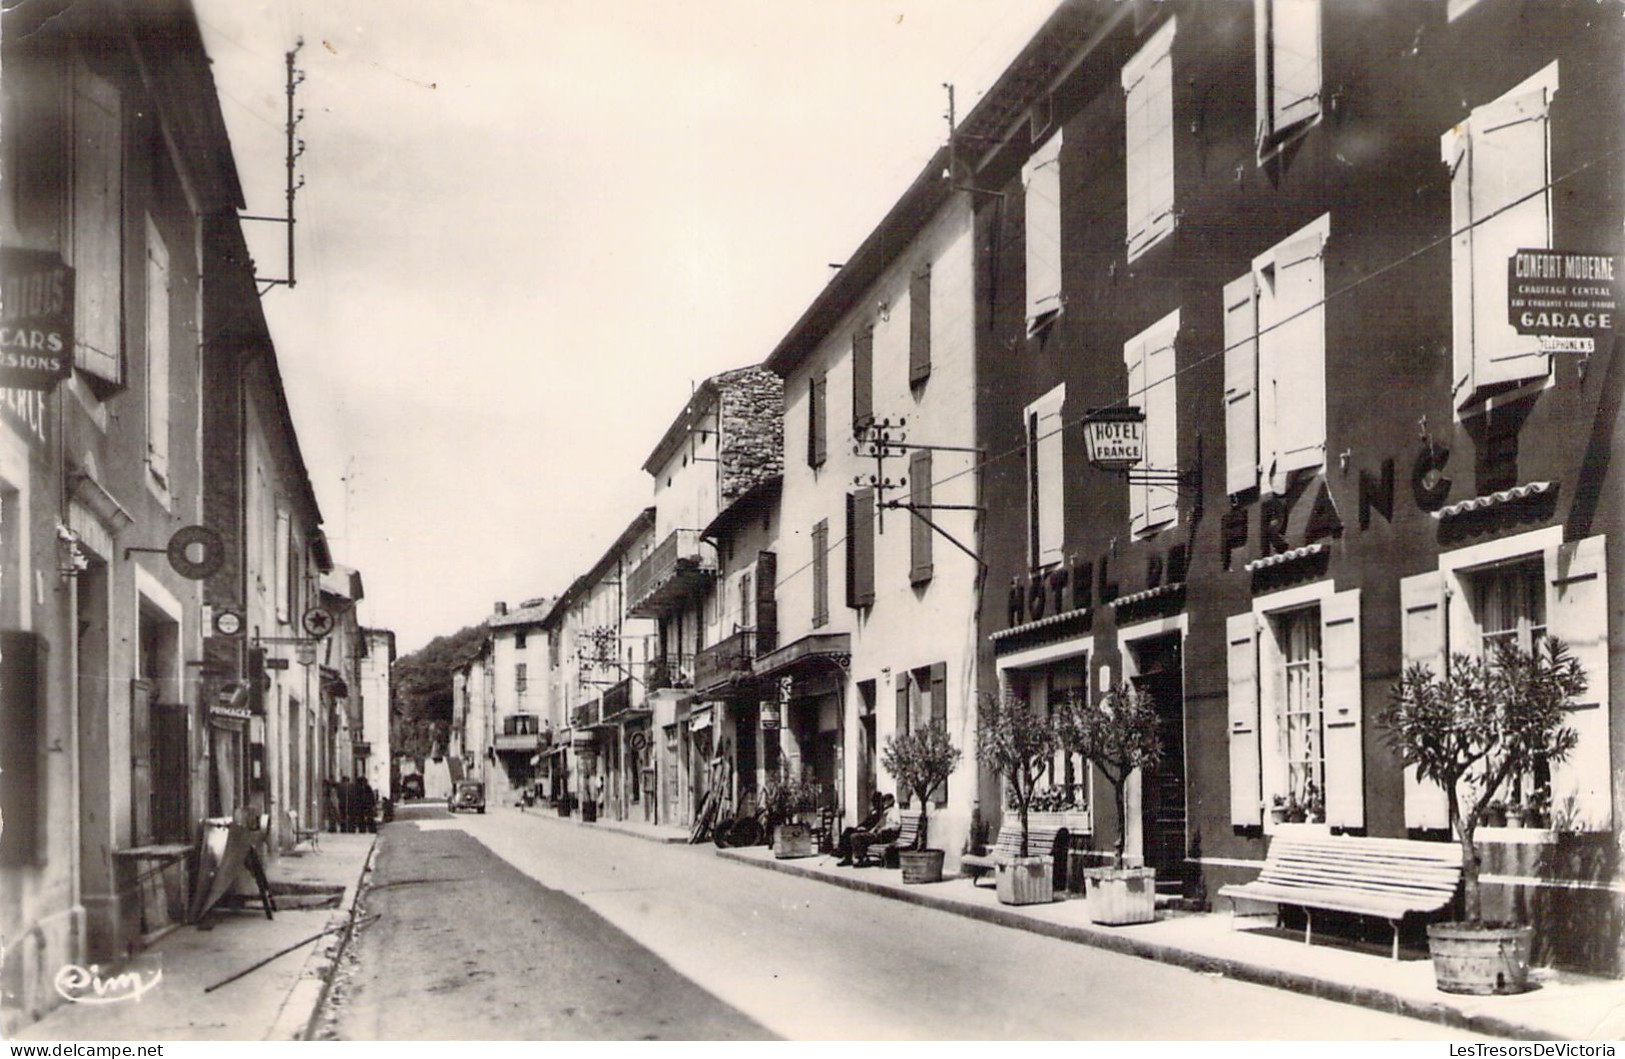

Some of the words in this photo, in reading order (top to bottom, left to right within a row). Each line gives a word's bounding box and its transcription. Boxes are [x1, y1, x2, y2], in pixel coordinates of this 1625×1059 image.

[1515, 253, 1562, 279] CONFORT
[1565, 255, 1614, 281] MODERNE
[1572, 286, 1611, 297] CENTRAL
[1521, 312, 1612, 329] GARAGE
[1097, 446, 1139, 459] FRANCE
